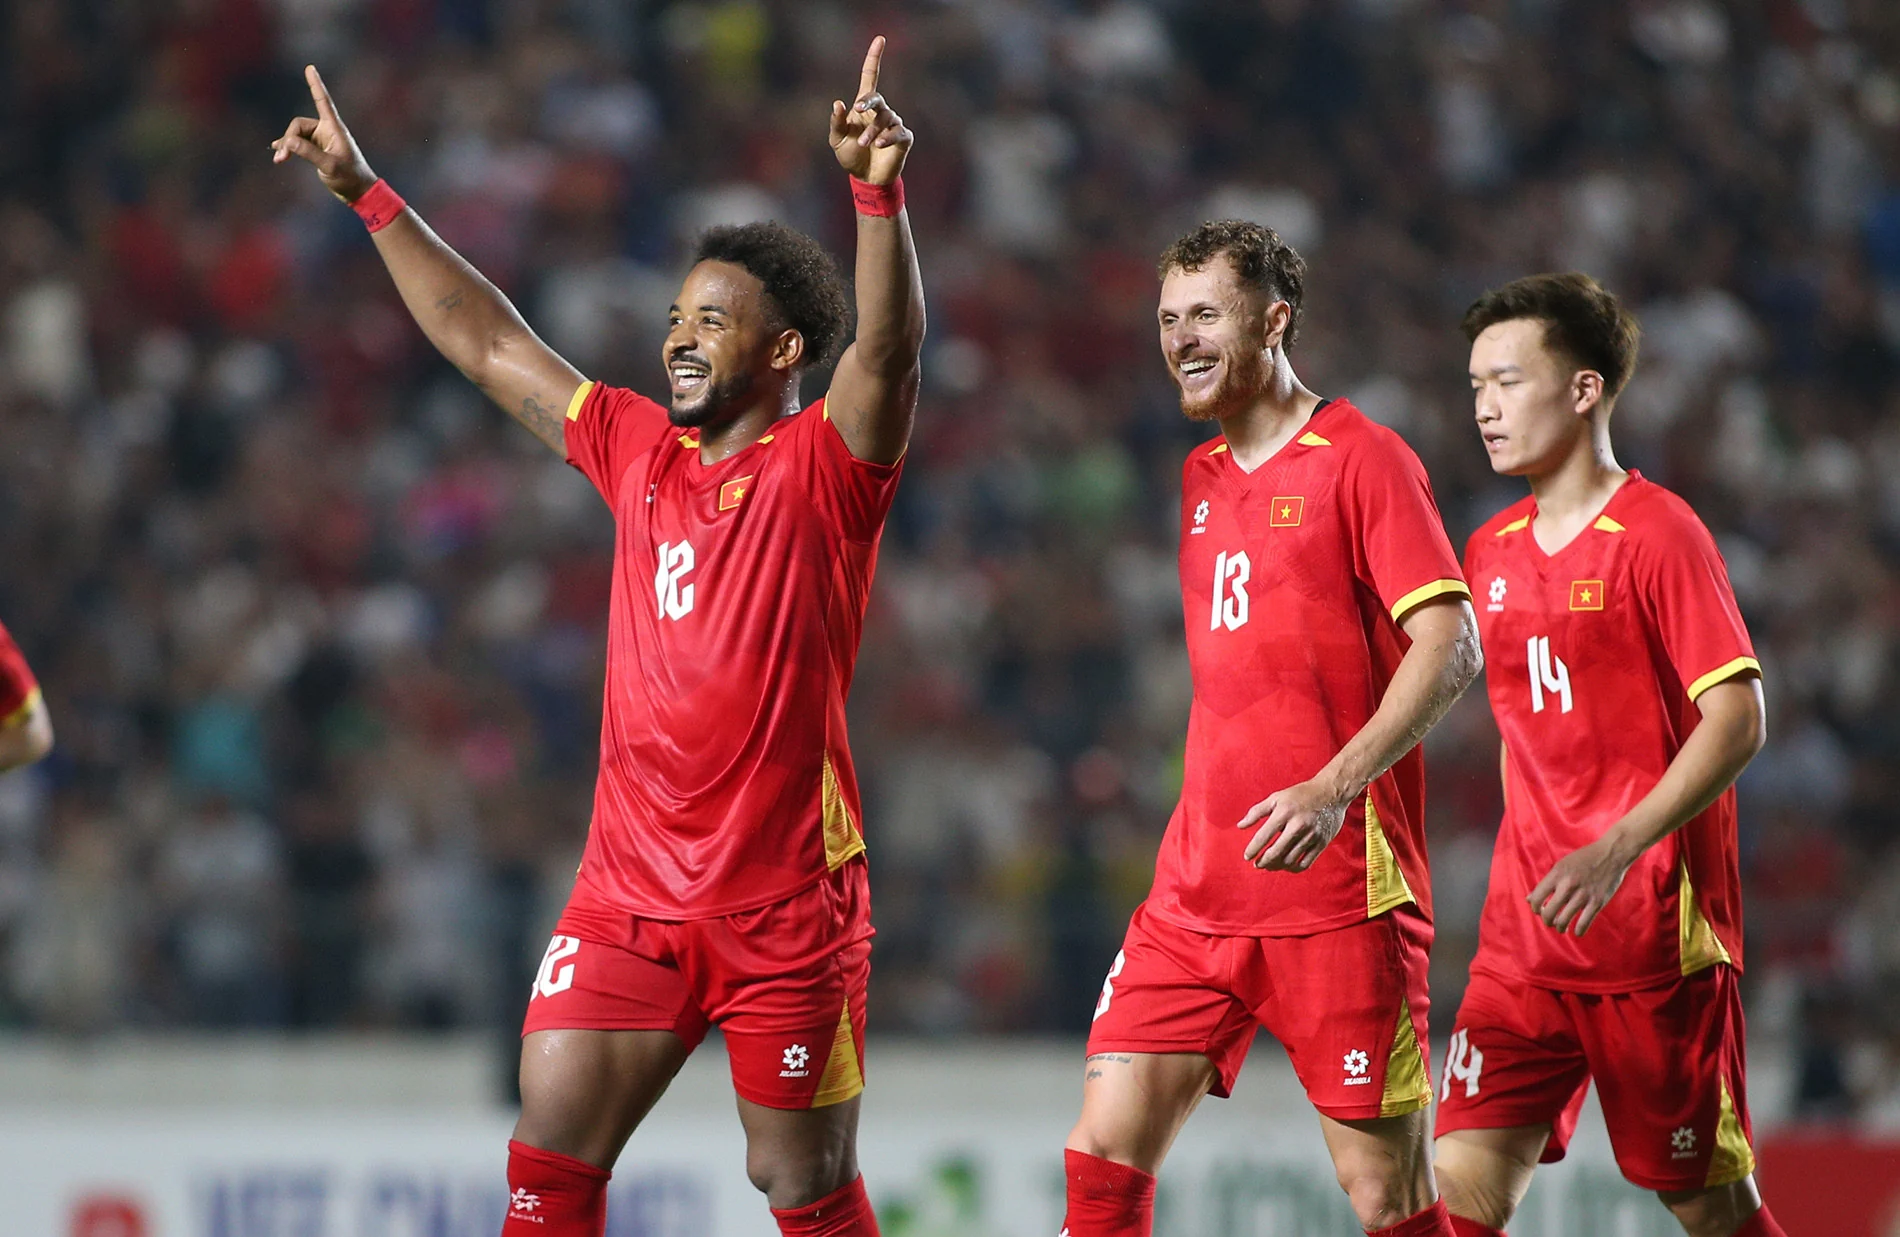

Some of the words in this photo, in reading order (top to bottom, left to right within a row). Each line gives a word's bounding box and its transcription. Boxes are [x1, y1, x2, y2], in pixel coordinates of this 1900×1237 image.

[655, 539, 695, 622] 12
[1210, 550, 1251, 632] 13
[1527, 635, 1573, 714] 14
[1441, 1027, 1484, 1103] 14
